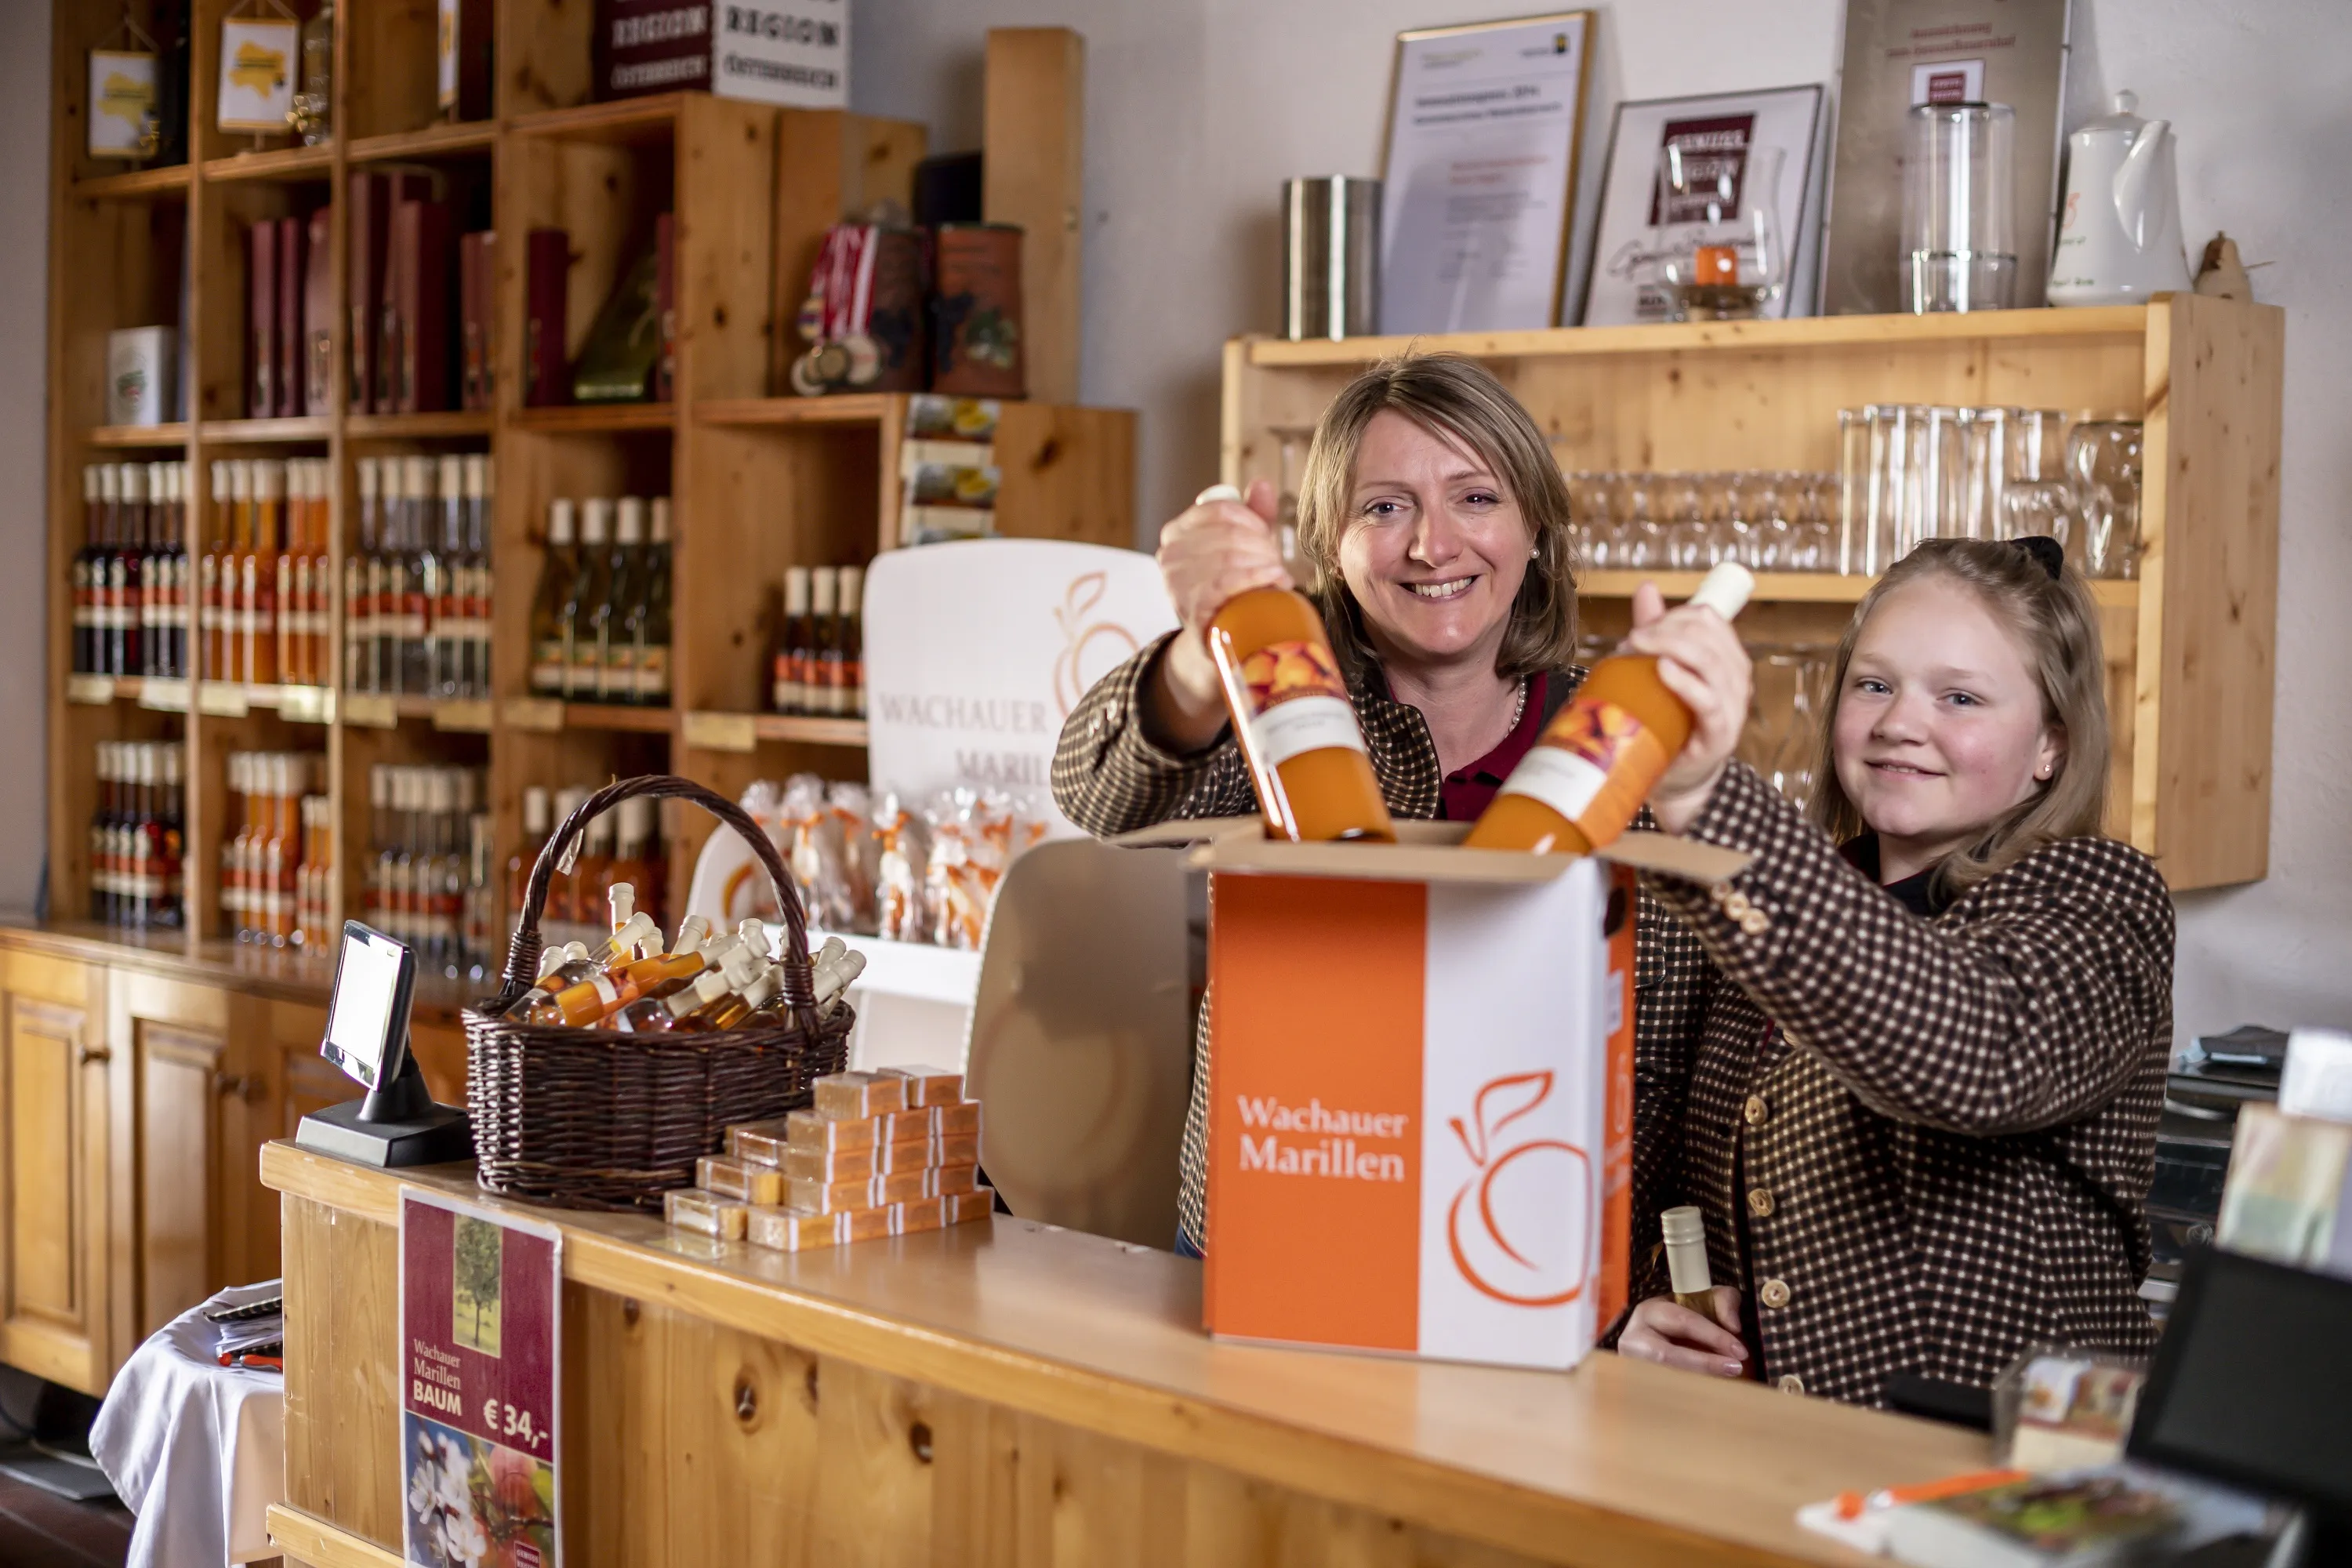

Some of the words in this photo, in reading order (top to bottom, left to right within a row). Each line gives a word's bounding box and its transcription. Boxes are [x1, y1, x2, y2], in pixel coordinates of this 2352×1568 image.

[612, 6, 708, 49] REGION
[724, 5, 840, 47] REGION
[877, 691, 1047, 734] WACHAUER
[954, 747, 1045, 787] MARIL
[1237, 1094, 1410, 1138] Wachauer
[1239, 1133, 1405, 1183] Marillen
[413, 1338, 461, 1368] Wachauer
[414, 1357, 461, 1390] Marillen
[413, 1379, 463, 1417] BAUM
[483, 1398, 499, 1430] €
[503, 1404, 549, 1449] 34,-
